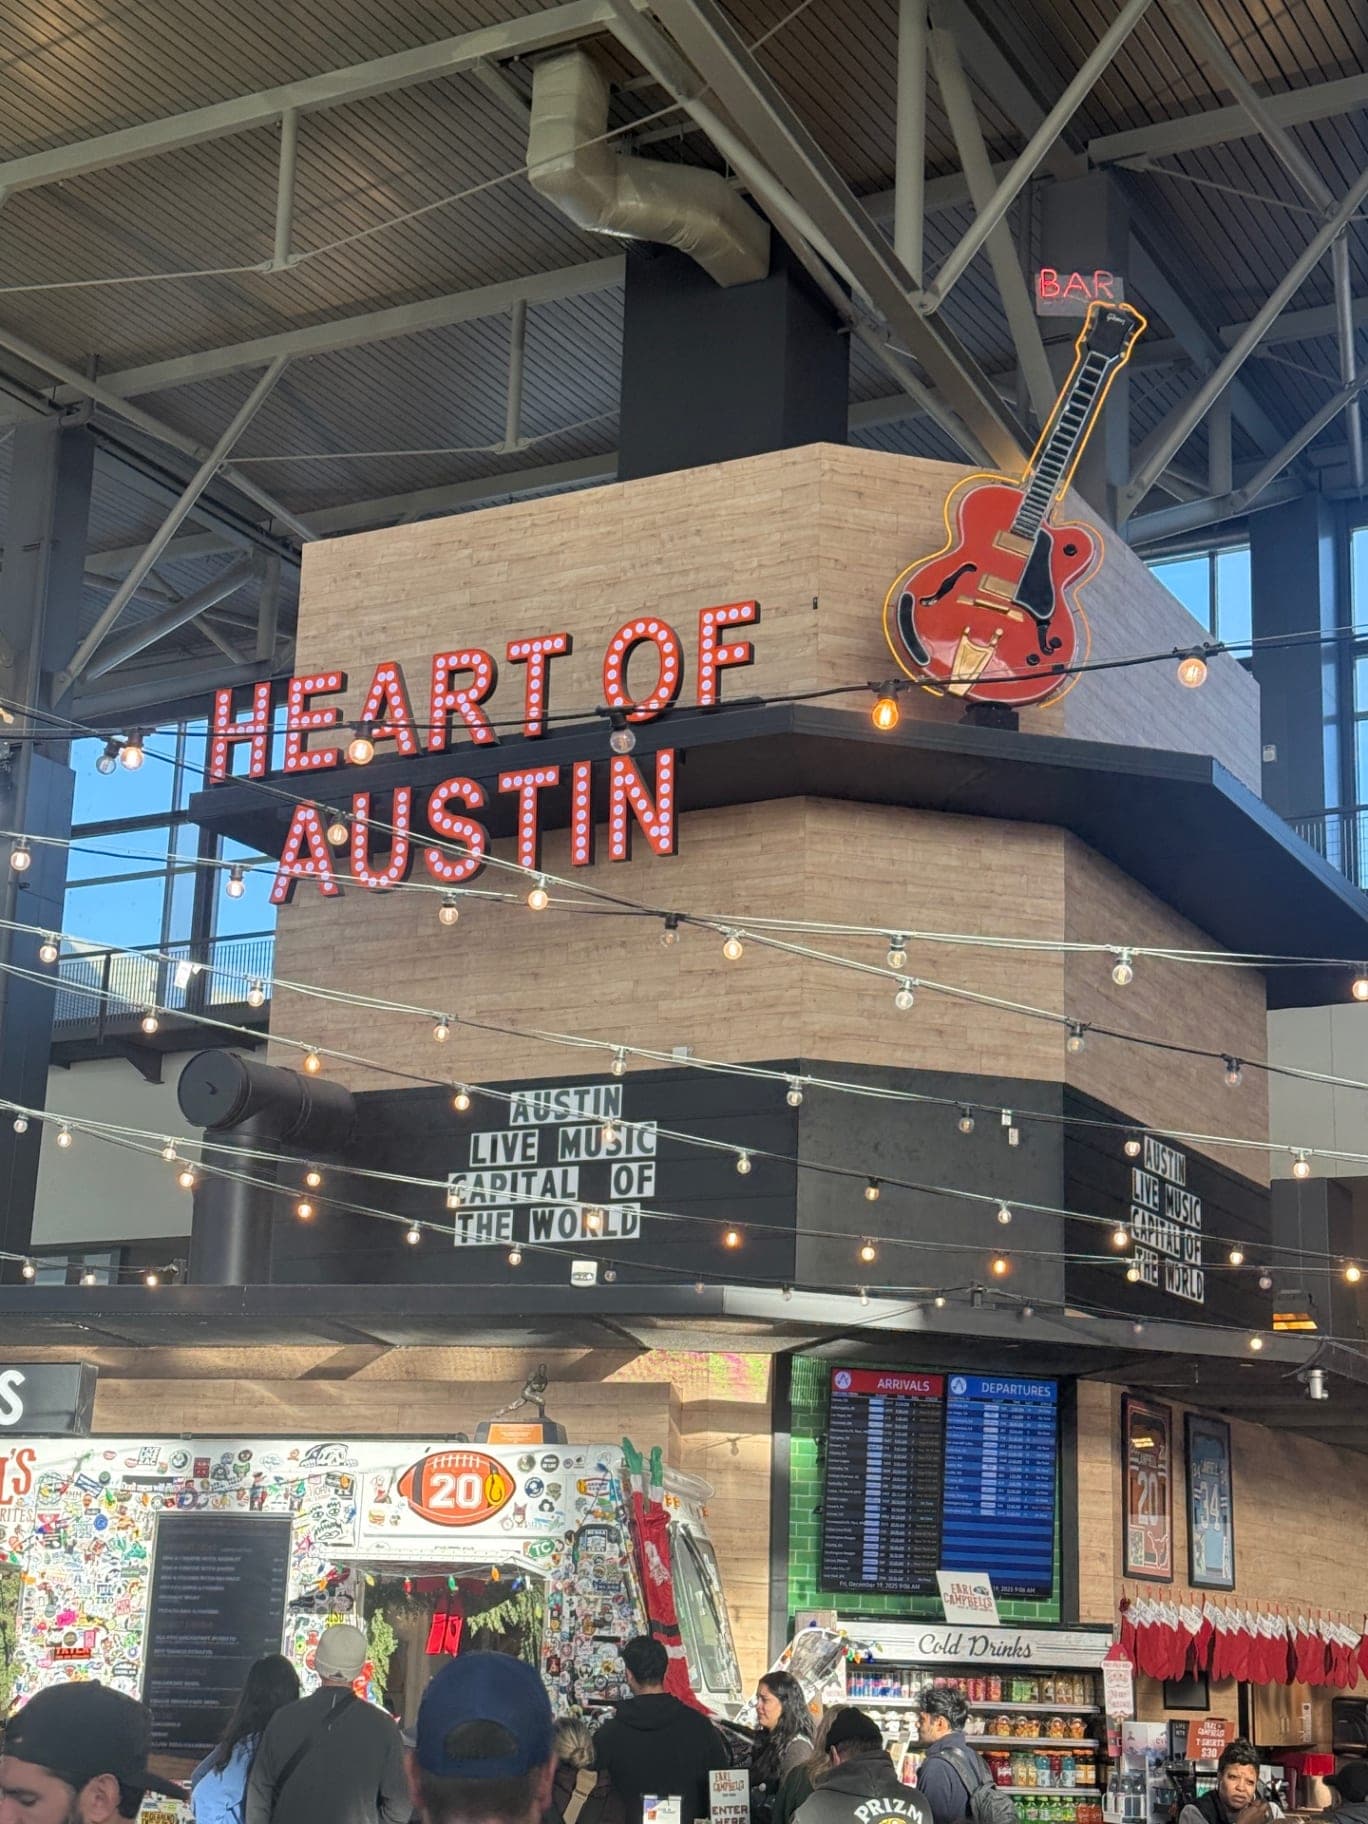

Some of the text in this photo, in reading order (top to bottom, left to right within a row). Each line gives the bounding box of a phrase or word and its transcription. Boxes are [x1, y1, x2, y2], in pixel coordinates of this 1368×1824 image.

[1040, 268, 1114, 299] BAR
[209, 600, 759, 783] HEART OF
[270, 747, 676, 904] AUSTIN
[511, 1085, 621, 1124] AUSTIN
[472, 1123, 655, 1165] LIVE MUSIC
[1145, 1137, 1186, 1186] AUSTIN
[613, 1163, 653, 1196] OF
[1133, 1169, 1201, 1228] LIVE MUSIC
[457, 1211, 512, 1243] THE
[1131, 1206, 1200, 1264] CAPITAL OF
[1166, 1259, 1204, 1302] WORLD
[0, 1369, 25, 1426] S
[877, 1378, 930, 1392] ARRIVALS
[981, 1382, 1051, 1397] DEPARTURES
[427, 1472, 484, 1510] 20
[1137, 1471, 1159, 1527] 20
[1200, 1480, 1221, 1532] 34
[532, 1541, 552, 1556] TC
[950, 1583, 975, 1596] EARL
[918, 1633, 1033, 1658] Cold Drinks
[1201, 1748, 1218, 1758] $30
[711, 1805, 749, 1815] ENTER
[853, 1797, 924, 1824] PRIZM
